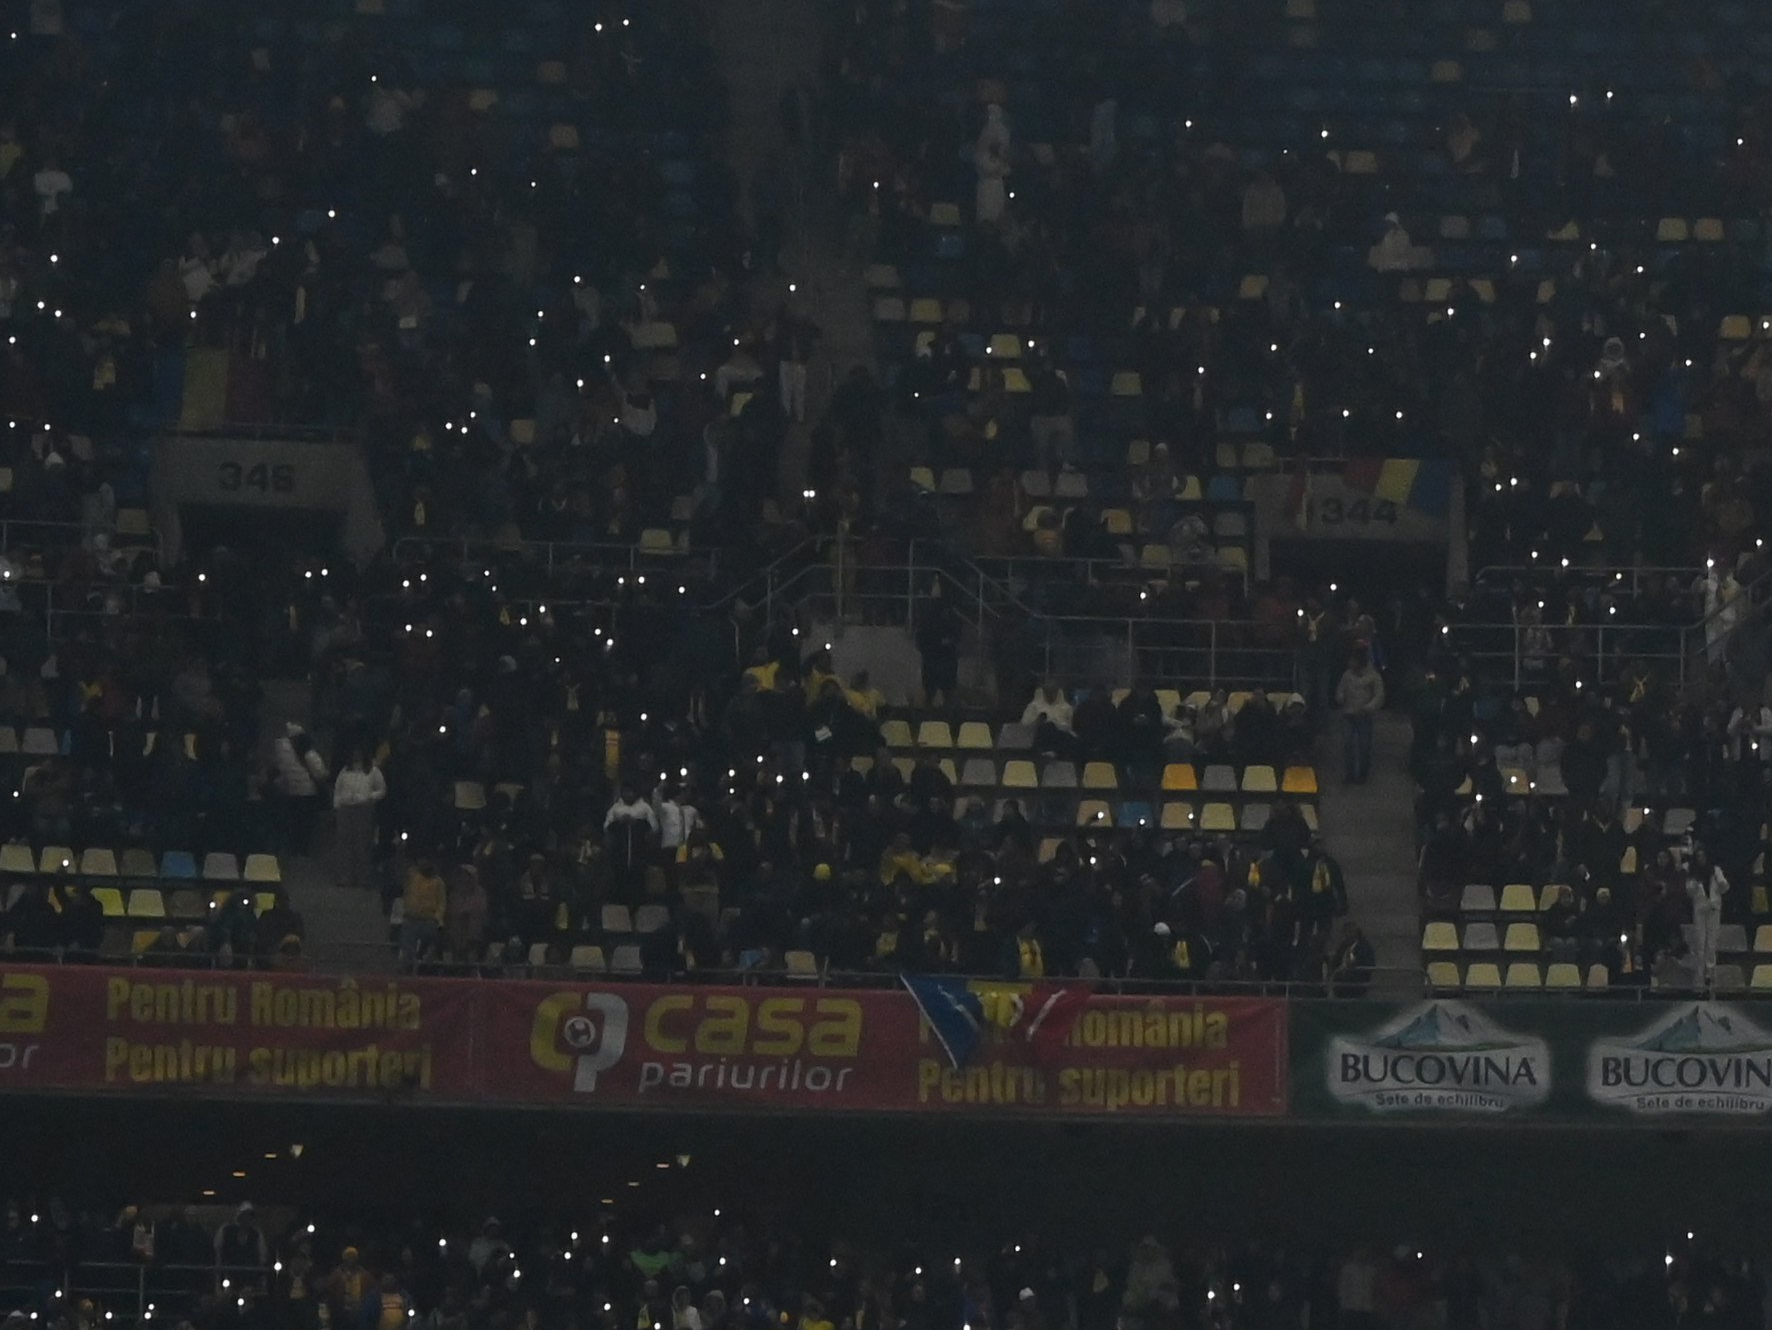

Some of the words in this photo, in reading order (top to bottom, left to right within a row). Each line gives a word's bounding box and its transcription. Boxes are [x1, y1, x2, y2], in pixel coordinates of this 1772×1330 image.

[107, 976, 238, 1024] Pentru
[250, 975, 421, 1031] România
[644, 994, 864, 1057] casa
[105, 1036, 237, 1084] Pentru
[248, 1042, 432, 1090] suporteri
[638, 1057, 853, 1093] pariurilor
[1341, 1053, 1537, 1086] BUCOVINA
[1058, 1060, 1240, 1111] suporteri
[1414, 1091, 1433, 1105] de
[1437, 1092, 1504, 1109] echilibru
[1675, 1094, 1694, 1108] de
[1698, 1094, 1766, 1111] echilibru
